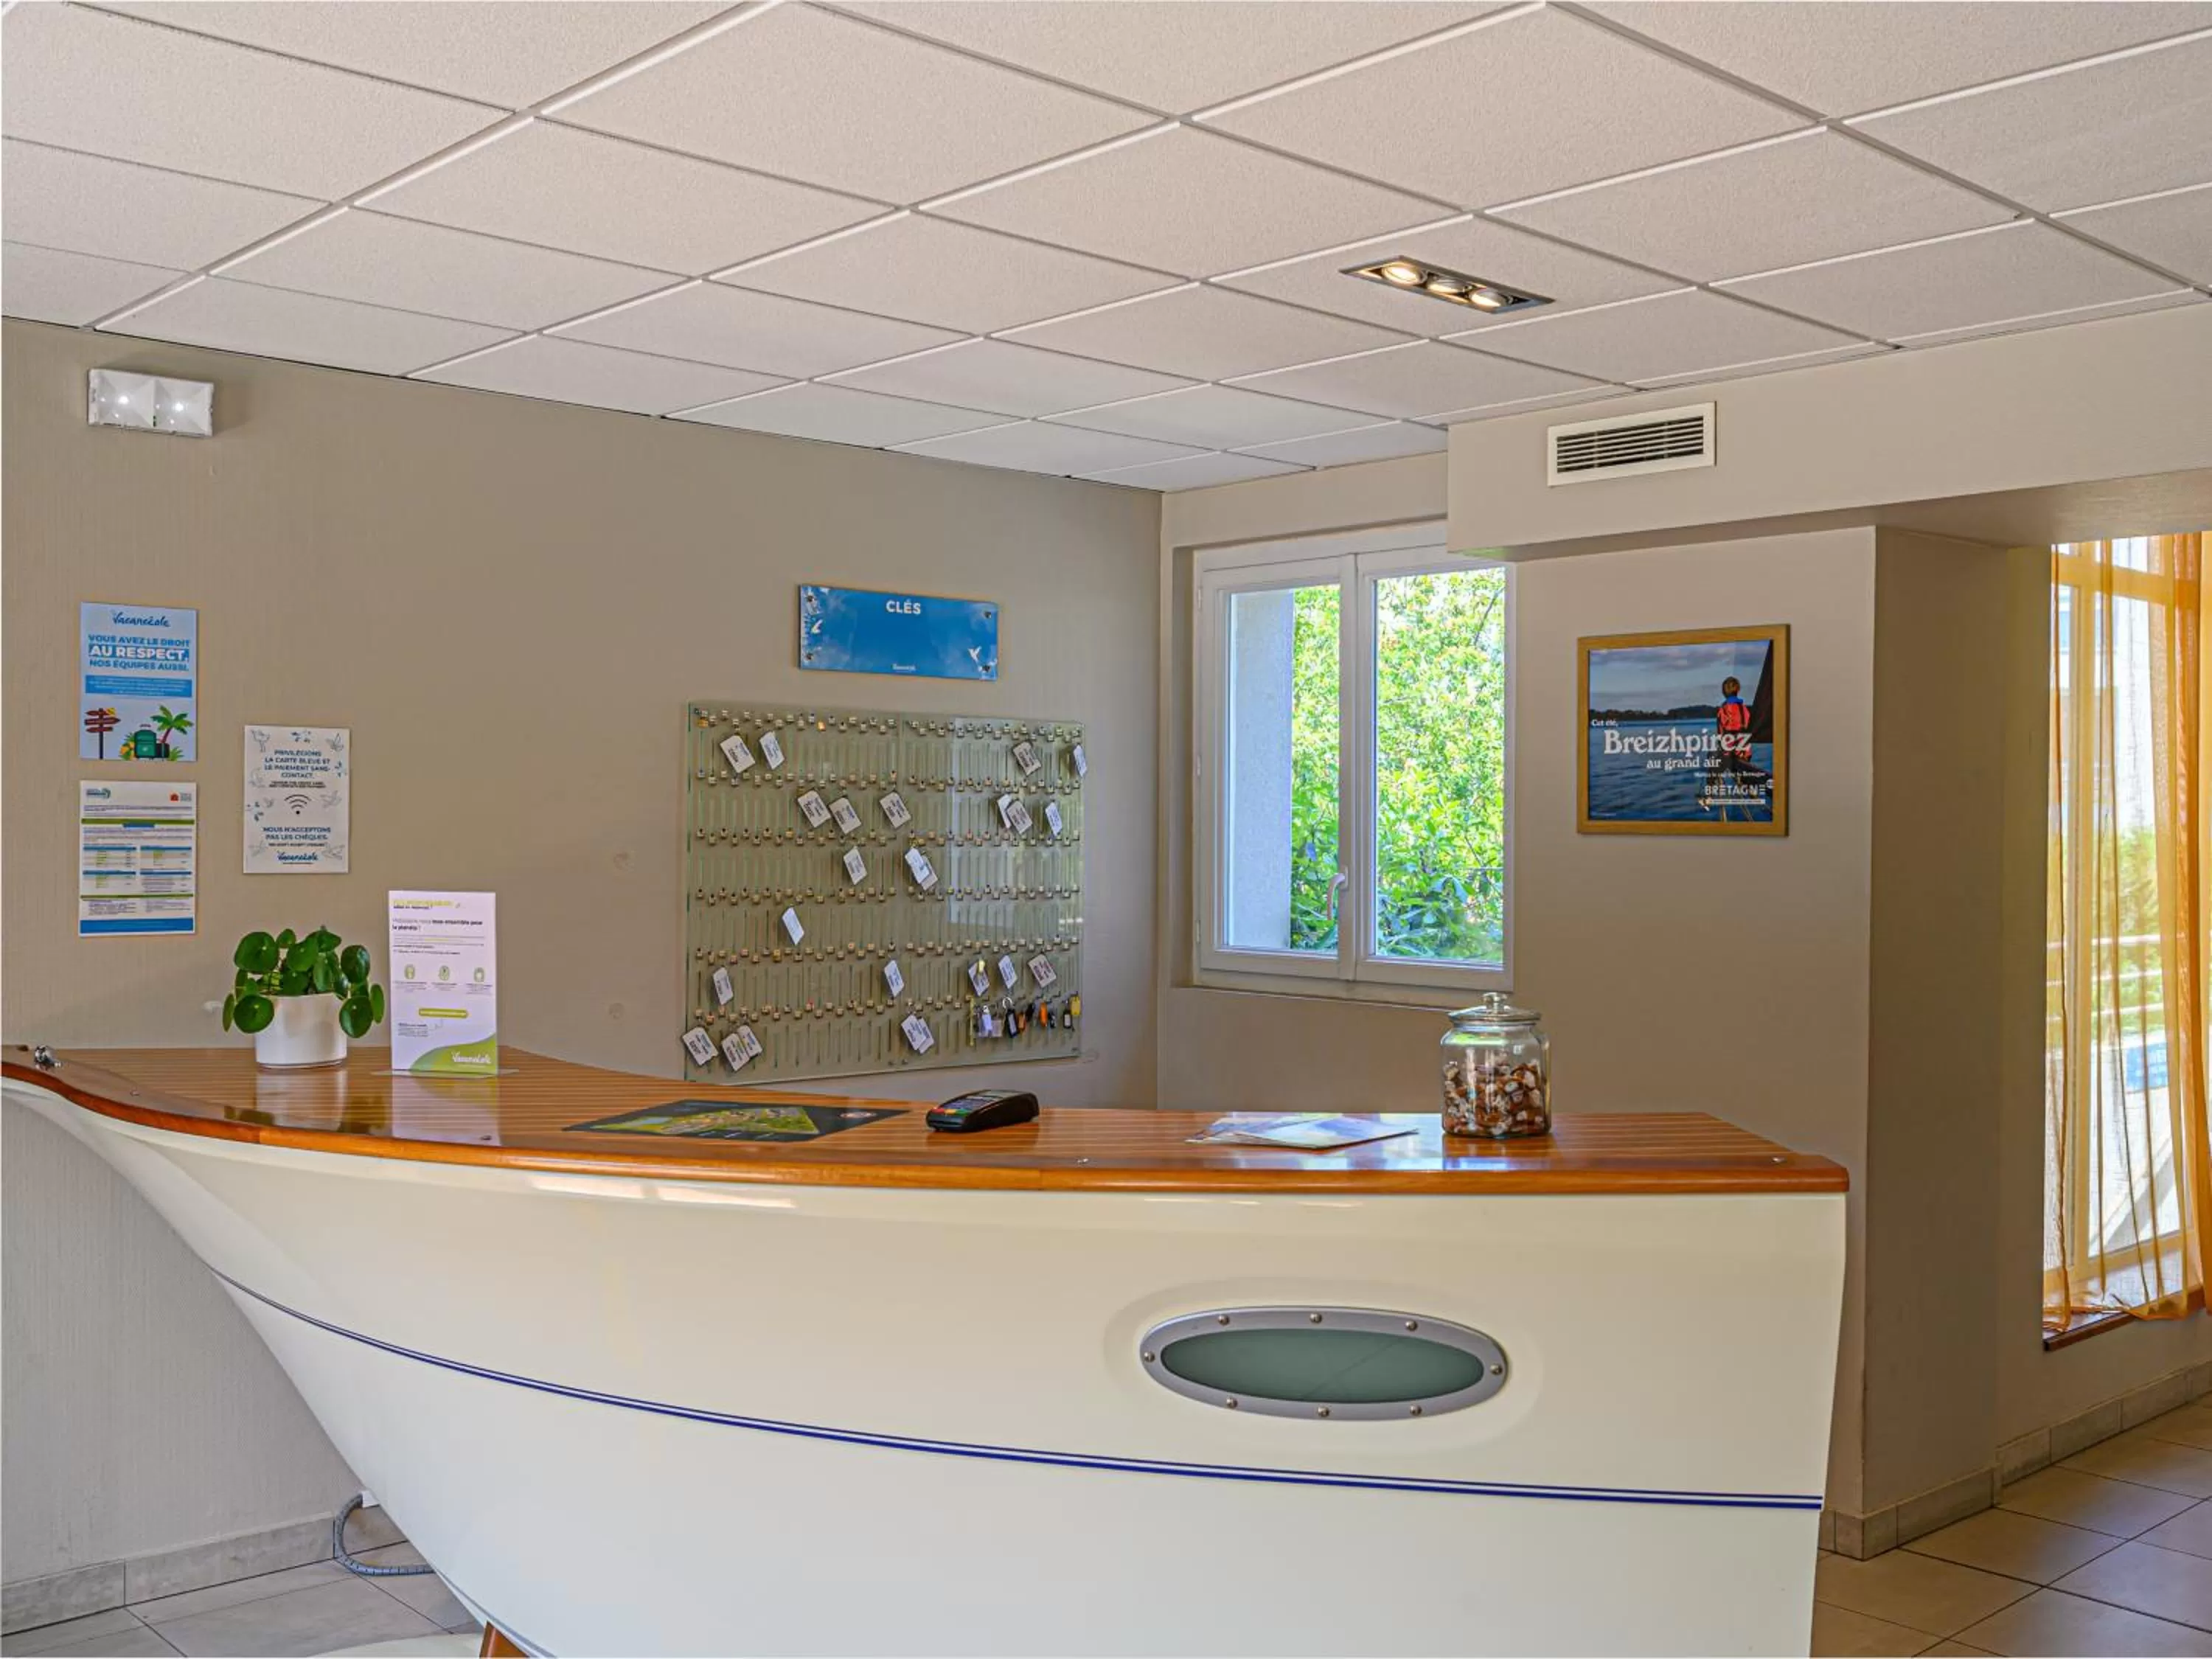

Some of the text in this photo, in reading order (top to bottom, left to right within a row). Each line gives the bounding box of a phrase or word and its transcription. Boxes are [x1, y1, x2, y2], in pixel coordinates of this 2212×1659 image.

[886, 599, 922, 615] CLÉS
[88, 635, 115, 644] VOUS
[118, 636, 145, 645] AVEZ
[160, 639, 189, 647] DROIT
[90, 645, 112, 656] AU
[89, 659, 111, 667] NOS
[1604, 727, 1752, 757] Breizhpirez
[1646, 757, 1722, 771] au grand air
[1705, 784, 1766, 796] BRETAGNE
